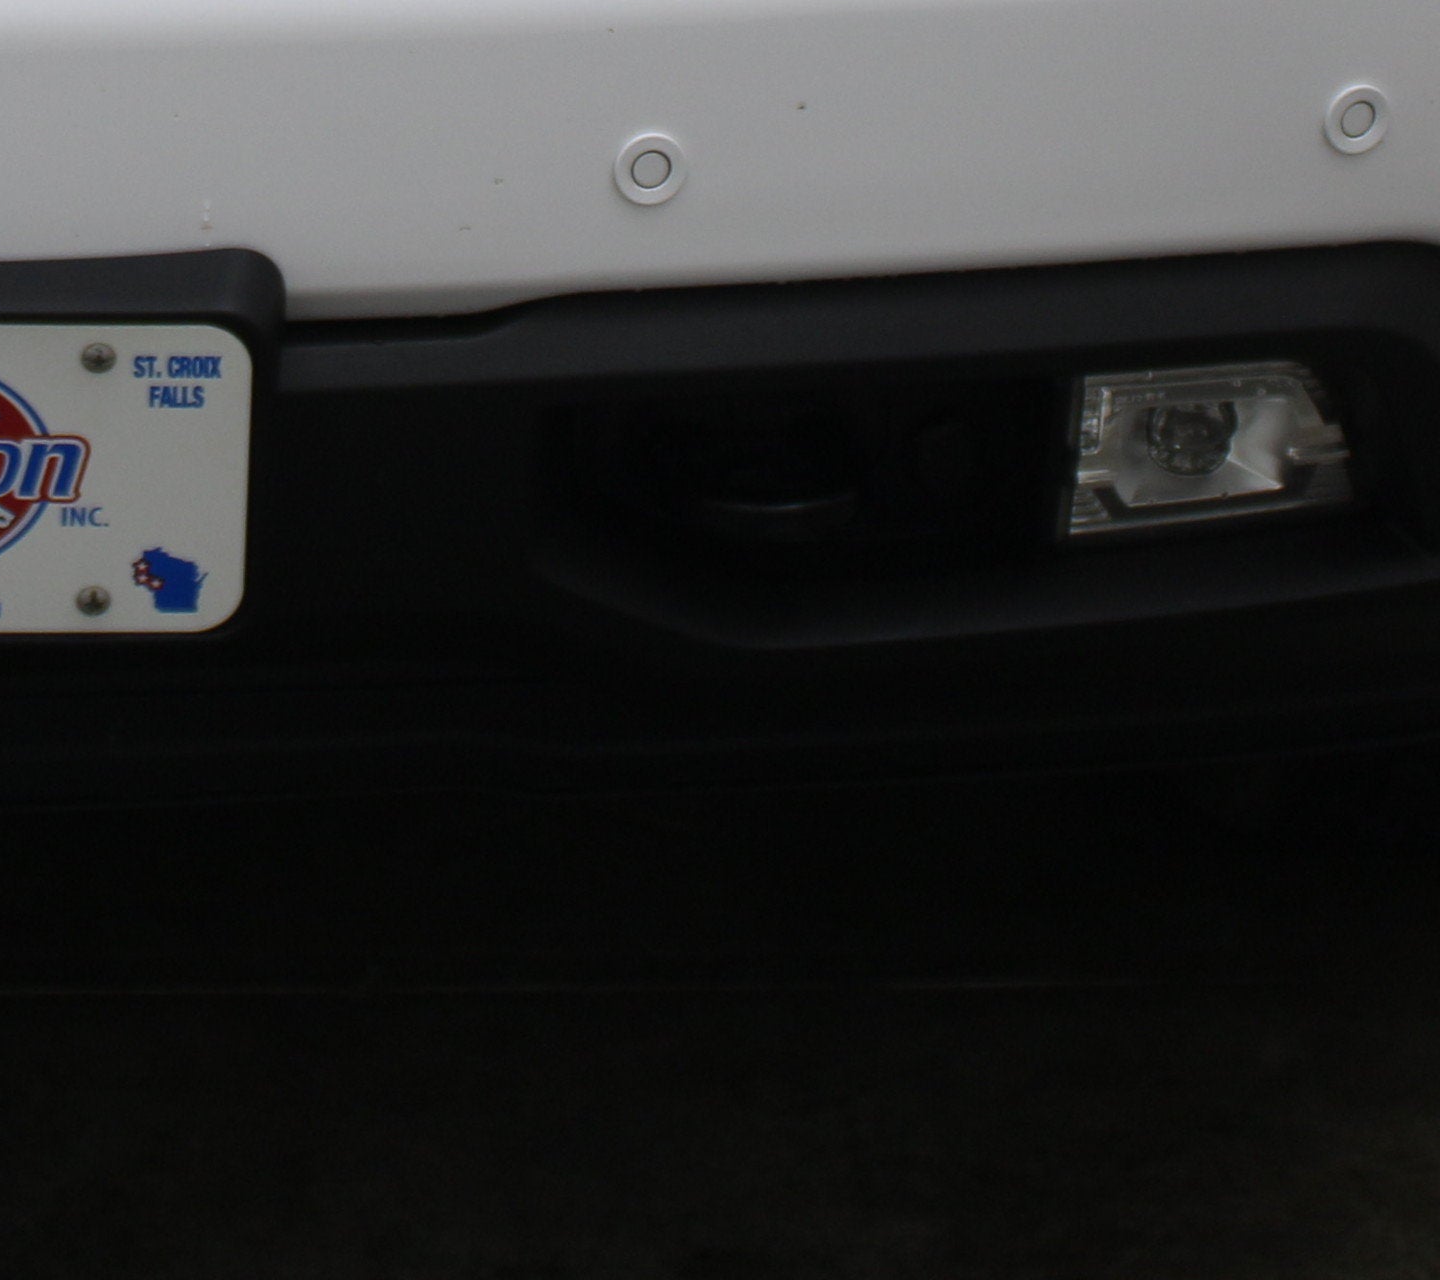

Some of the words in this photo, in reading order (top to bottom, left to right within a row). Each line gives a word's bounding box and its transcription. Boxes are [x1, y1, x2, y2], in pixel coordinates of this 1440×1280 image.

[133, 355, 162, 378] ST.
[167, 355, 222, 379] CROIX
[148, 385, 205, 408] FALLS
[61, 506, 110, 528] INC.
